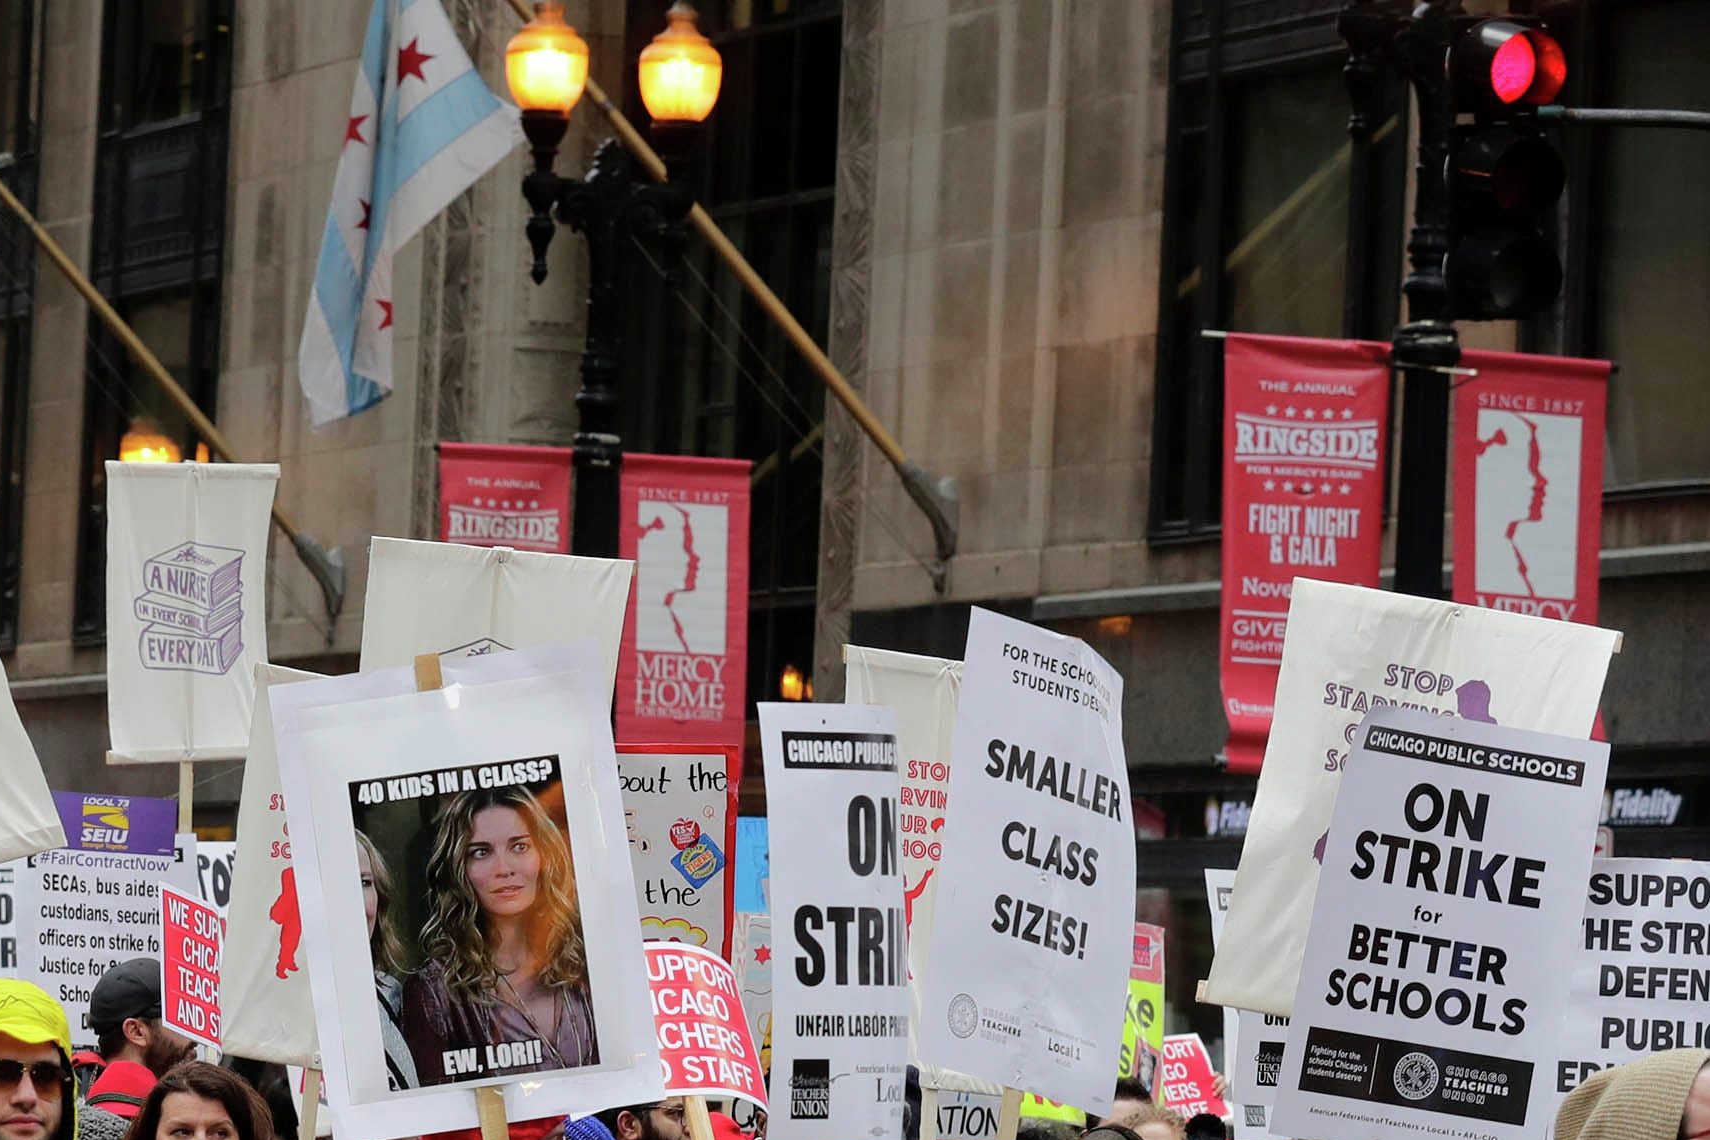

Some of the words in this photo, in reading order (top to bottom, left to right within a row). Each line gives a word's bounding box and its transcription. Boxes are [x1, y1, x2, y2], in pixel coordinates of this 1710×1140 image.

[1258, 380, 1289, 393] THE
[1294, 381, 1356, 396] ANNUAL
[1478, 392, 1537, 411] SINCE
[1542, 398, 1585, 416] 1887
[1235, 420, 1379, 460] RINGSIDE
[638, 486, 687, 501] SINCE
[449, 512, 559, 542] RINGSIDE
[1248, 503, 1301, 534] FIGHT
[1304, 507, 1360, 538] NIGHT
[1269, 534, 1283, 563] &
[1287, 537, 1337, 566] GALA
[150, 565, 164, 590] A
[167, 567, 207, 604] NURSE
[152, 607, 178, 621] EVERY
[636, 652, 727, 683] MERCY
[1003, 643, 1029, 665] FOR
[1033, 652, 1058, 673] THE
[1012, 670, 1080, 703] STUDENTS
[1384, 663, 1454, 696] STOP
[635, 681, 725, 709] HOME
[788, 739, 853, 764] CHICAGO
[1369, 731, 1425, 754] CHICAGO
[1427, 743, 1485, 766] PUBLIC
[1488, 751, 1577, 781] SCHOOLS
[358, 781, 384, 805] 40
[387, 775, 435, 802] KIDS
[439, 771, 460, 793] IN
[462, 769, 476, 791] A
[478, 758, 553, 789] CLASS?
[688, 762, 728, 792] the
[985, 738, 1122, 823] SMALLER
[83, 797, 114, 806] LOCAL
[118, 799, 129, 807] 73
[1404, 782, 1490, 842] ON
[1611, 788, 1682, 823] Fidelity
[80, 827, 128, 844] SEIU
[41, 851, 170, 872] #FairContractNow
[1001, 821, 1099, 886] CLASS
[1350, 830, 1546, 909] STRIKE
[42, 874, 91, 896] SECAs,
[96, 877, 120, 895] bus
[645, 878, 701, 907] the
[41, 902, 113, 924] custodians,
[168, 897, 190, 929] WE
[991, 893, 1089, 960] SIZES!
[1414, 905, 1442, 924] for
[39, 929, 86, 948] officers
[89, 935, 105, 949] on
[109, 934, 144, 952] strike
[1347, 923, 1507, 985] BETTER
[39, 956, 85, 975] Justice
[89, 959, 105, 976] for
[177, 998, 205, 1031] AND
[1325, 968, 1527, 1036] SCHOOLS
[796, 1014, 845, 1038] UNFAIR
[848, 1014, 887, 1038] LABOR
[981, 1018, 1022, 1038] TEACHERS
[442, 1047, 484, 1075] EW,
[486, 1040, 543, 1068] LORI!
[1048, 1037, 1073, 1059] Local
[1310, 1044, 1337, 1059] Fighting
[1338, 1049, 1348, 1060] for
[1349, 1051, 1361, 1061] the
[682, 1055, 754, 1091] STAFF
[1307, 1066, 1335, 1079] students
[1336, 1070, 1362, 1082] deserve
[1308, 1056, 1334, 1068] schools
[1335, 1058, 1368, 1073] Chicago's
[1445, 1065, 1508, 1084] CHICAGO
[792, 1088, 829, 1101] TEACHERS
[1442, 1088, 1485, 1105] UNION
[1444, 1077, 1509, 1097] TEACHERS
[792, 1101, 829, 1117] UNION
[1385, 1118, 1419, 1131] Teachers
